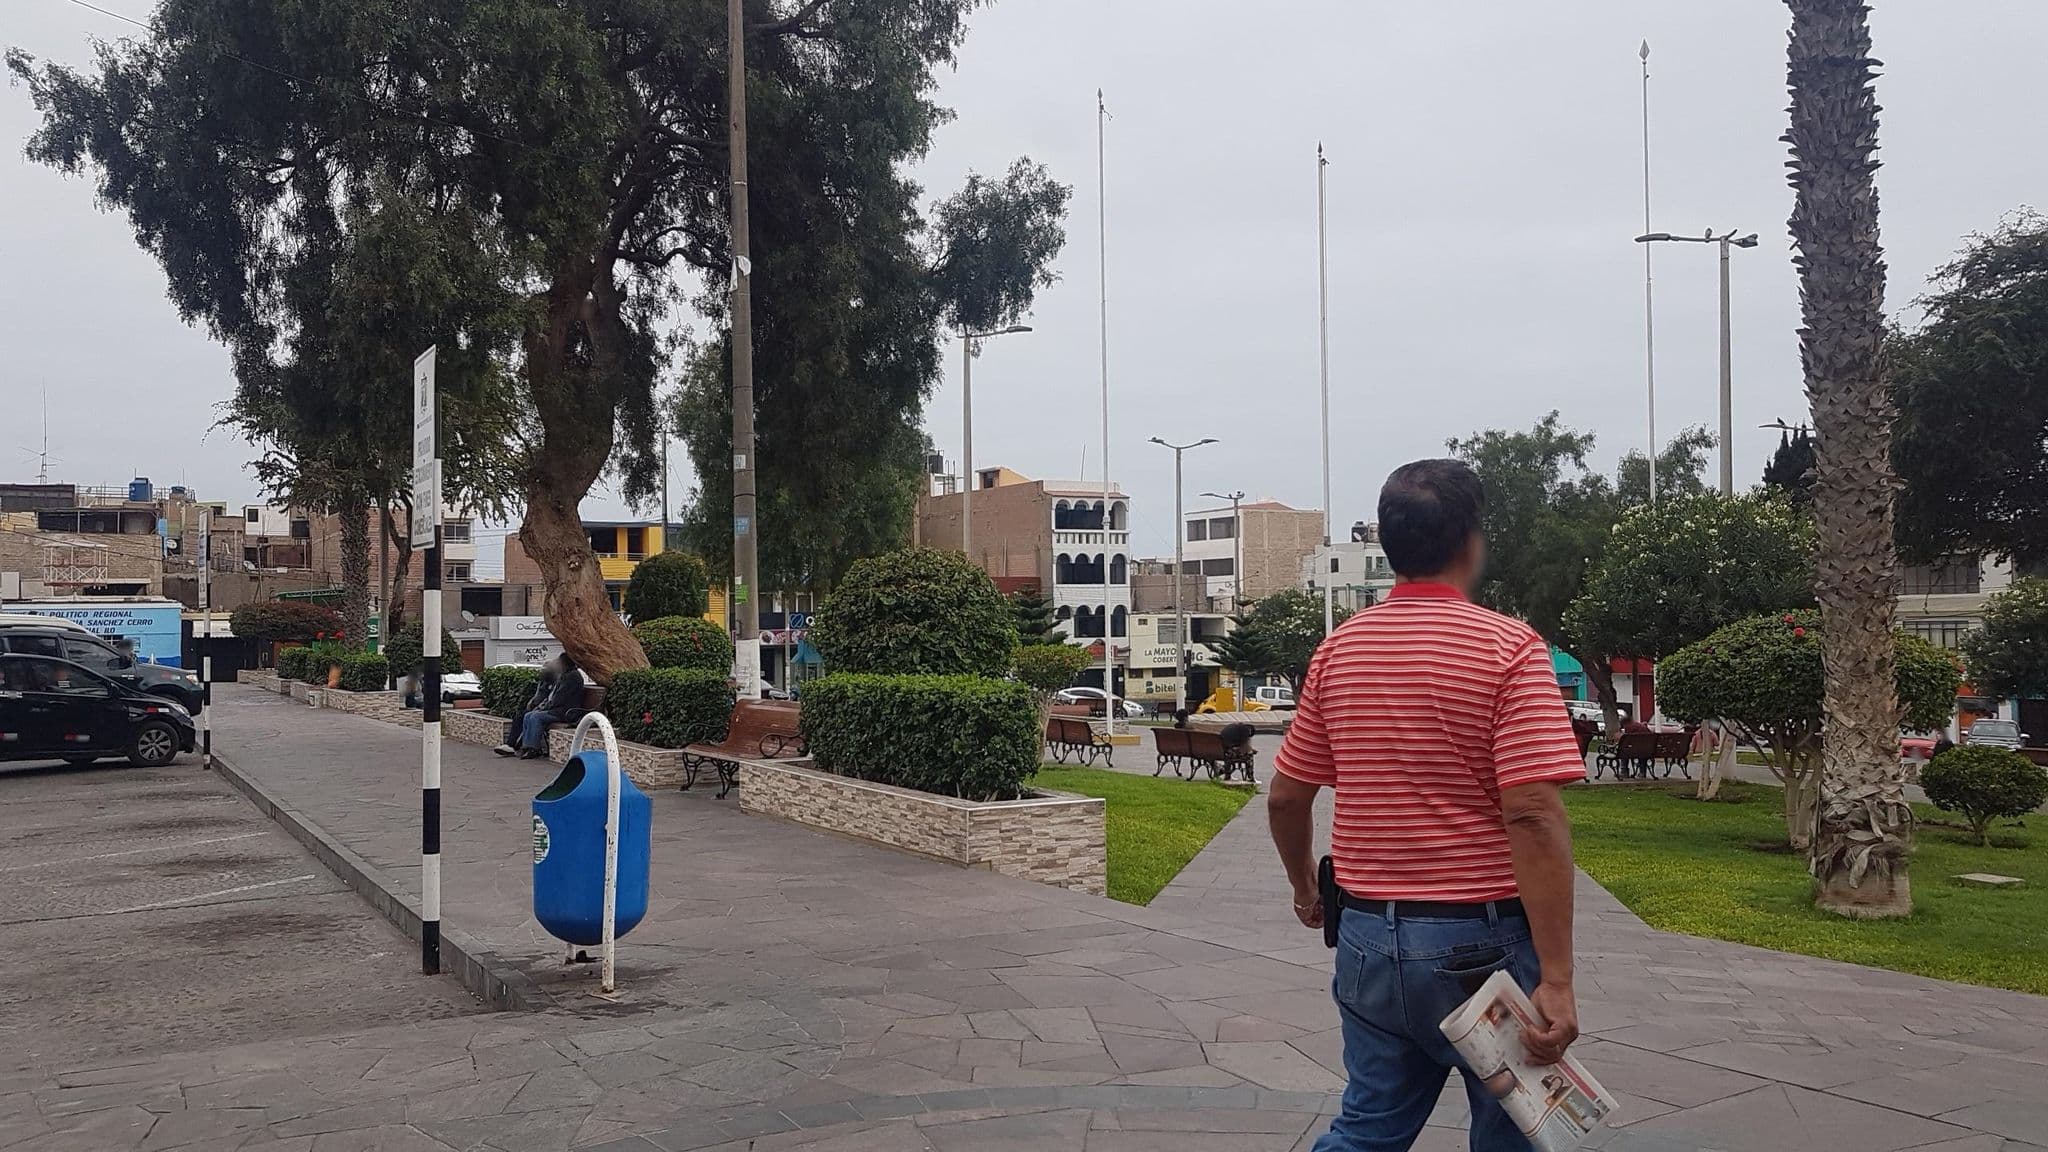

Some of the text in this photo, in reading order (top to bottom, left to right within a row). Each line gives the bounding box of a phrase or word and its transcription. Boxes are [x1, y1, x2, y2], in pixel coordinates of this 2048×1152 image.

[87, 619, 124, 627] SANCHEZ
[1153, 647, 1177, 657] MAYO
[1155, 683, 1176, 693] bitel
